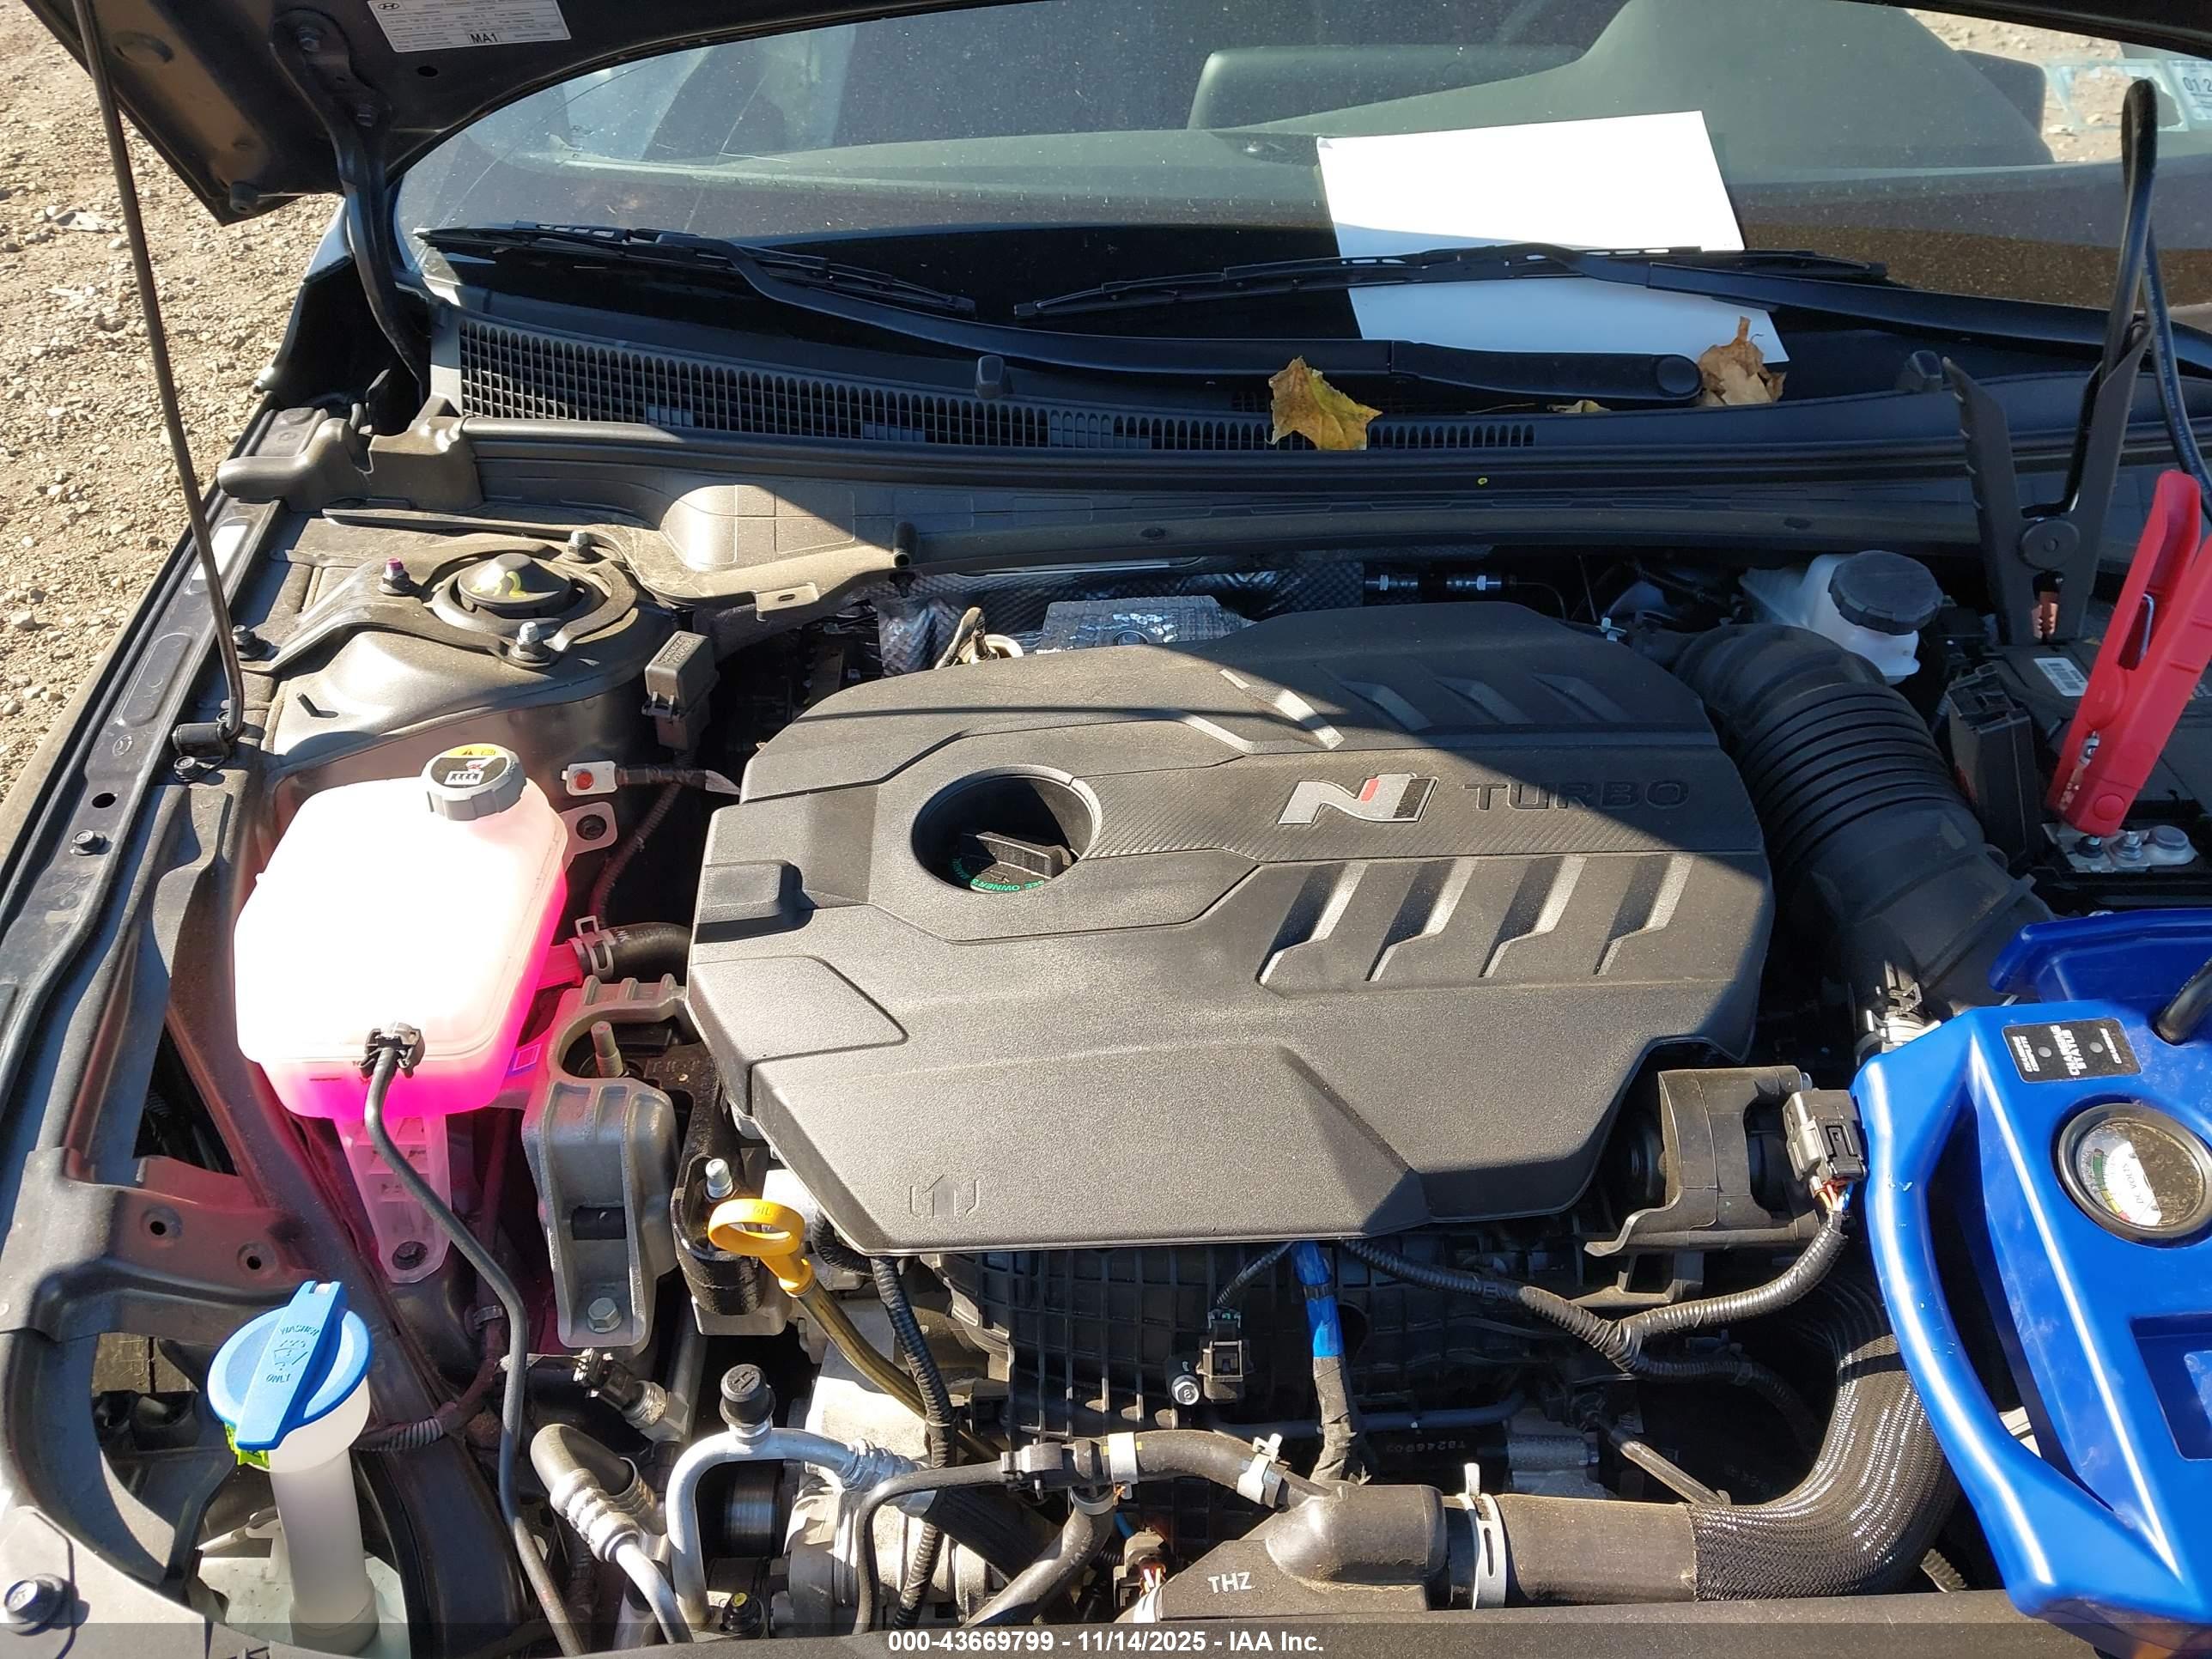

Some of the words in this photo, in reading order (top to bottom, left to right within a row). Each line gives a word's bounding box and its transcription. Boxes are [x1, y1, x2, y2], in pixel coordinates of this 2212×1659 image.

[471, 33, 498, 43] MA1
[1462, 779, 1691, 811] TURBO
[971, 878, 1020, 891] OWNER'S
[1024, 880, 1045, 890] SEE
[2051, 1024, 2081, 1076] CHARGING
[2061, 1030, 2087, 1070] STATUS
[754, 1206, 771, 1217] OIL
[280, 1325, 320, 1337] WASHER
[266, 1373, 291, 1383] ONLY
[1207, 1571, 1254, 1594] THZ
